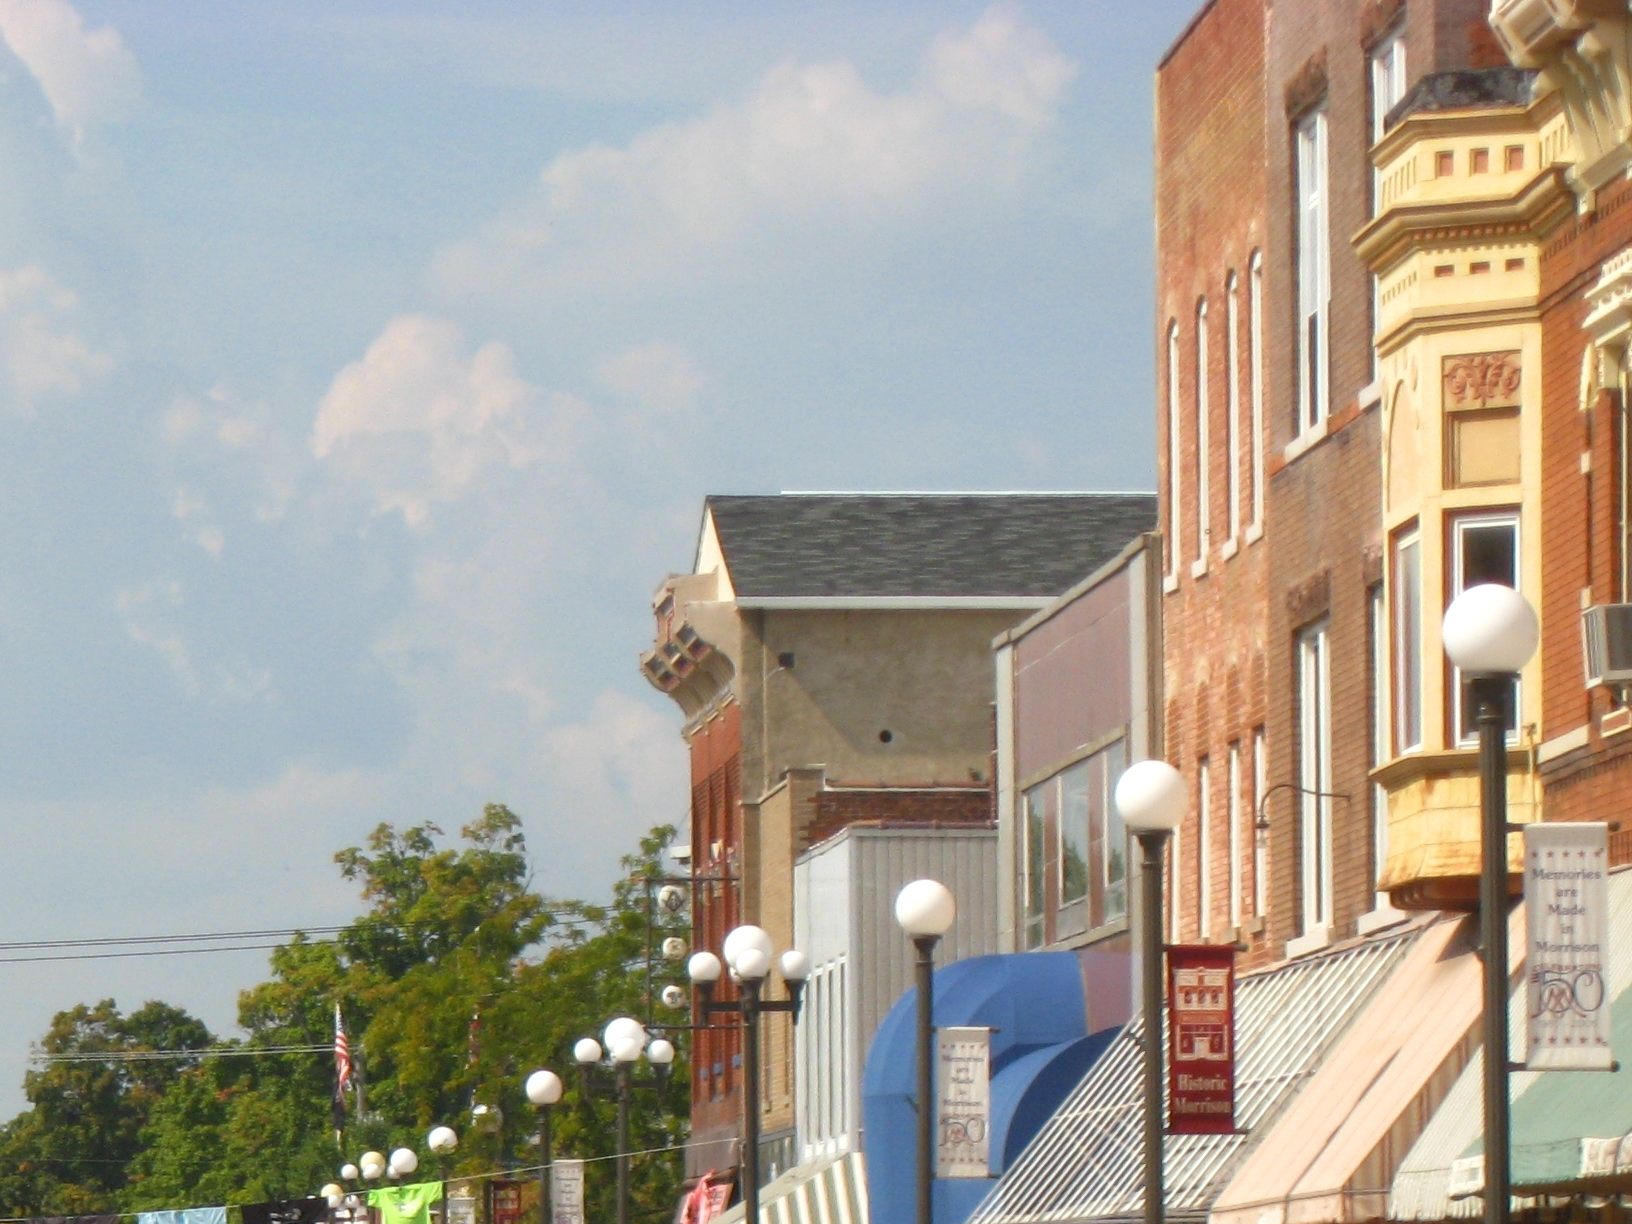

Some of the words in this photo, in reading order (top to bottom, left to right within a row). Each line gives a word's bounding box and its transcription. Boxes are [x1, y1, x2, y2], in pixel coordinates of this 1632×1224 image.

[1531, 867, 1602, 880] Memories
[1555, 887, 1578, 898] are
[1548, 904, 1586, 916] Made
[1561, 925, 1574, 935] in
[1535, 940, 1600, 953] Morrison
[1177, 1074, 1228, 1091] Historic
[1175, 1097, 1231, 1115] Morrison
